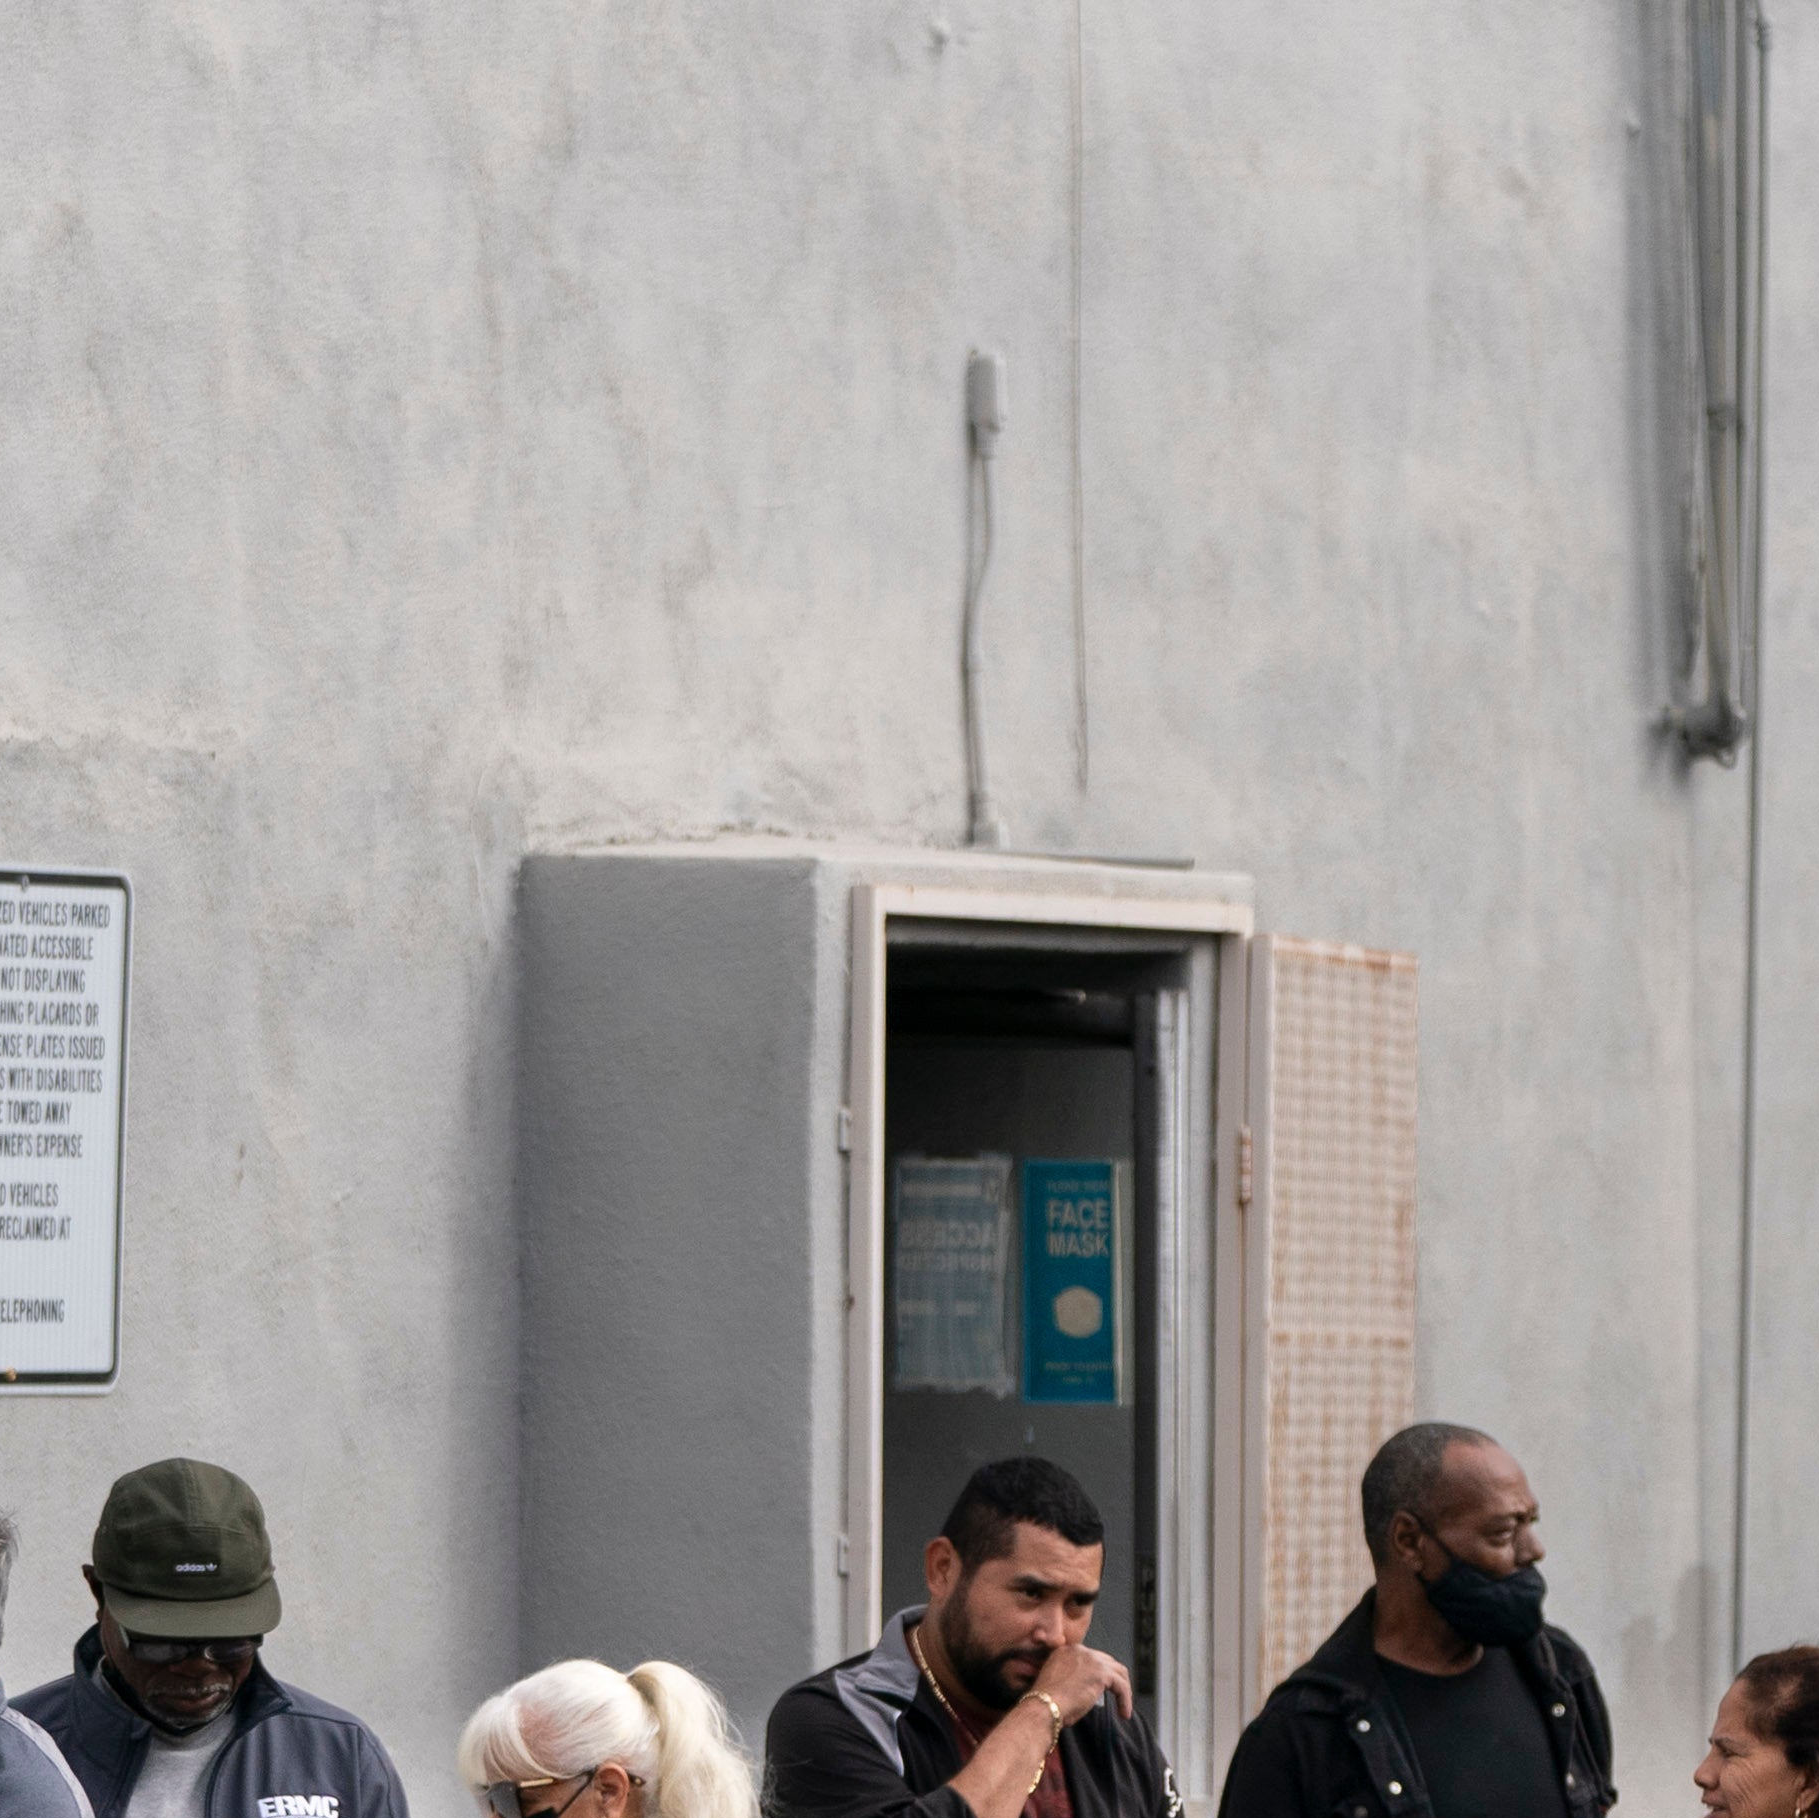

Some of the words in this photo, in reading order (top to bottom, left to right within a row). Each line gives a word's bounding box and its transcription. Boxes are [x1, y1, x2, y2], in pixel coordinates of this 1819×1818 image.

[19, 900, 68, 926] VEHICLES
[71, 903, 111, 928] PARKED
[31, 935, 94, 960] ACCESSIBLE
[1, 967, 21, 990] NOT
[24, 968, 86, 993] DISPLAYING
[27, 1001, 82, 1026] PLACARDS
[85, 1002, 100, 1027] OR
[26, 1034, 65, 1059] PLATES
[68, 1035, 106, 1060] ISSUED
[8, 1067, 33, 1091] WITH
[37, 1068, 103, 1093] DISABILITIES
[7, 1101, 42, 1124] TOWED
[45, 1101, 72, 1125] AWAY
[36, 1134, 83, 1158] EXPENSE
[10, 1183, 59, 1207] VEHICLES
[0, 1216, 56, 1240] RECLAIMED
[59, 1216, 71, 1240] AT
[1047, 1199, 1110, 1231] FACE
[1047, 1231, 1110, 1258] MASK
